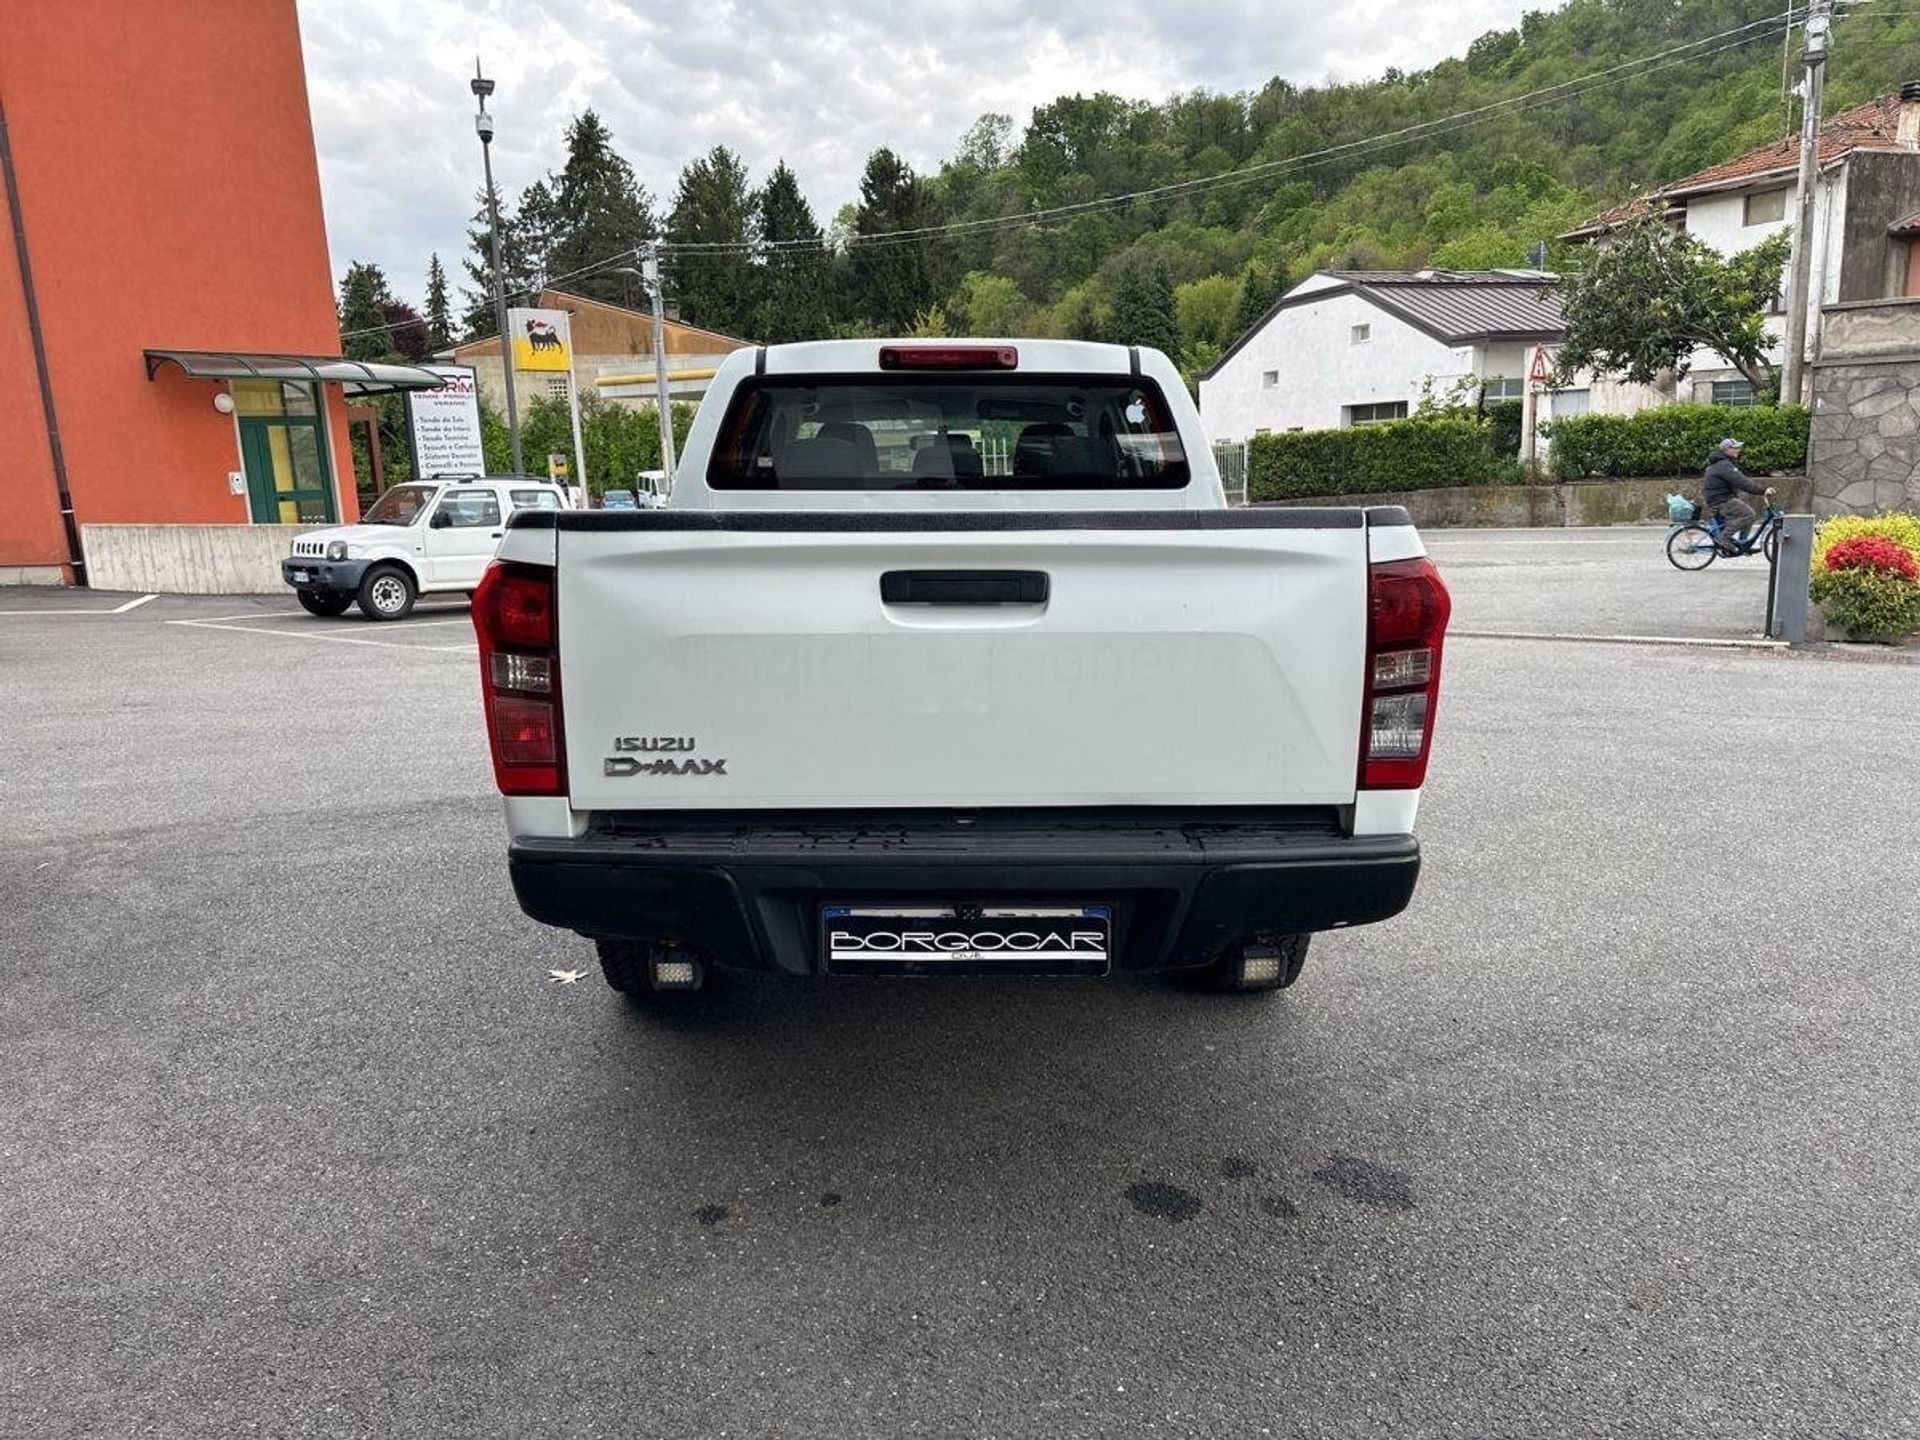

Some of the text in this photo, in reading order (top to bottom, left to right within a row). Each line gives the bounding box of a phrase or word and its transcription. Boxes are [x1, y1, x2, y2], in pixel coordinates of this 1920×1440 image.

[614, 737, 695, 751] ISUZU
[604, 757, 727, 777] D-MAX
[830, 931, 1105, 951] BORGOCAR
